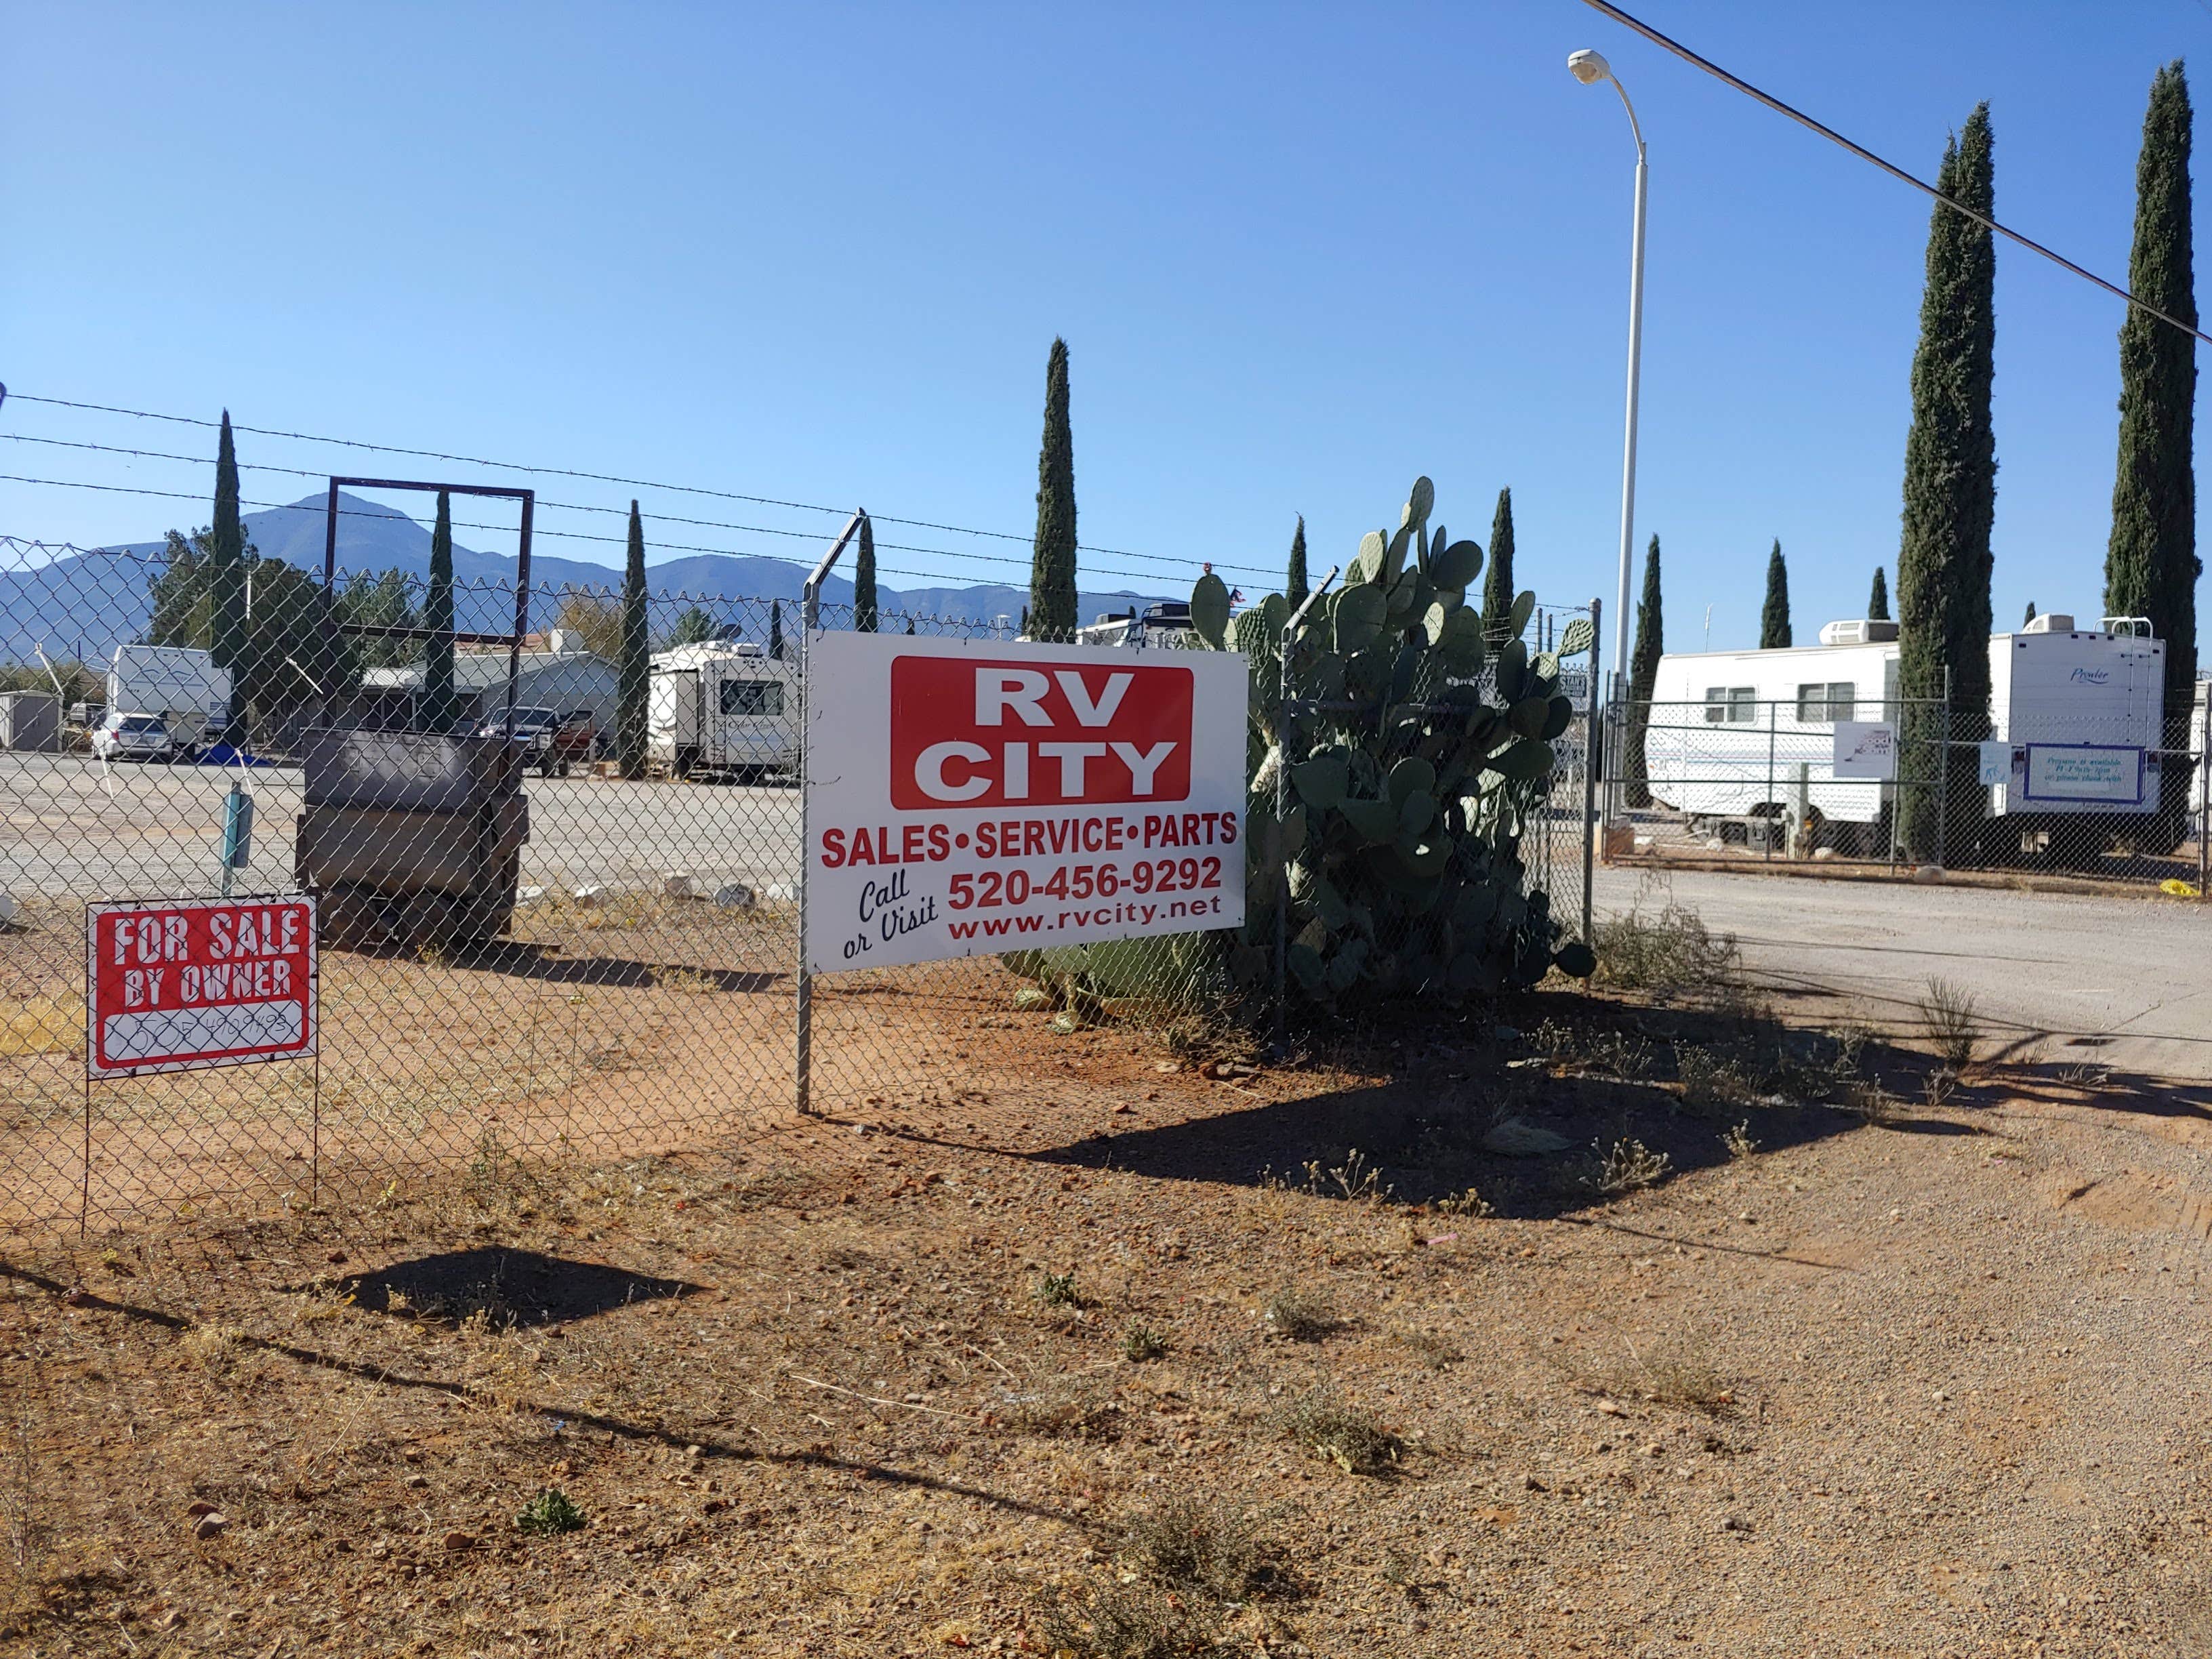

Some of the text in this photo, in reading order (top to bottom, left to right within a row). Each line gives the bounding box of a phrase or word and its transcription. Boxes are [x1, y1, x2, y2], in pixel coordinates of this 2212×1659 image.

[975, 667, 1134, 727] RV
[914, 741, 1178, 802] CITY
[821, 812, 1237, 869] SALES SERVICE PARTS
[859, 868, 910, 922] Call
[948, 856, 1222, 910] 520-456-9292
[114, 909, 300, 965] FOR SALE
[844, 896, 939, 959] or Visit
[948, 895, 1221, 940] www.rvcity.net
[125, 960, 291, 1008] BY OWNER
